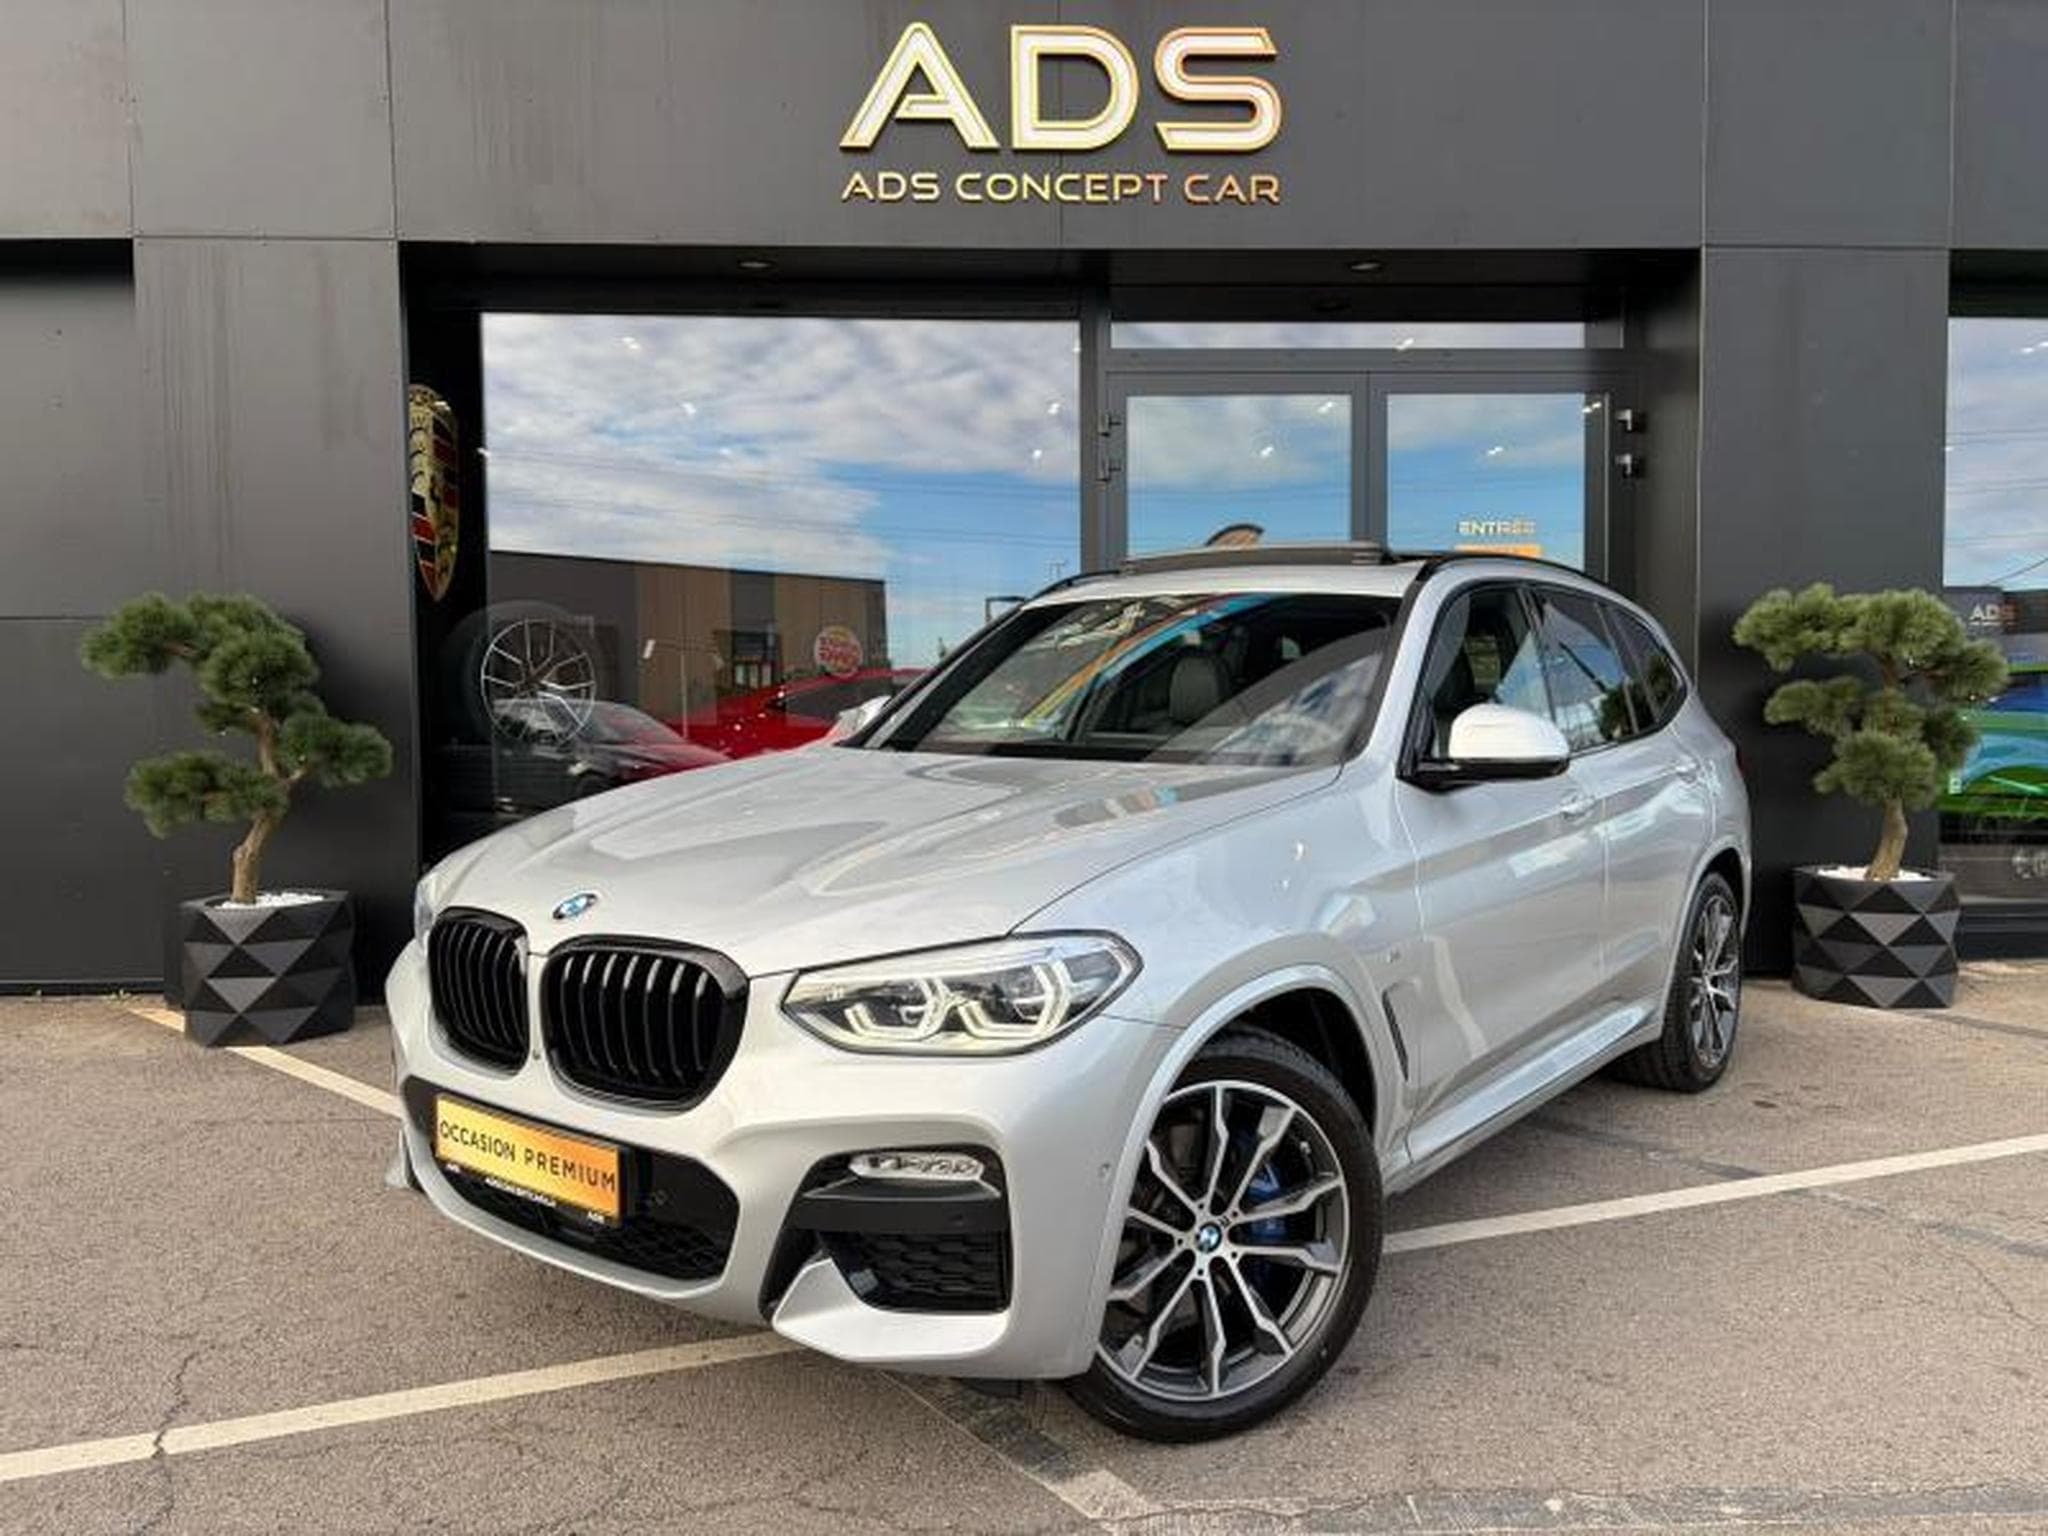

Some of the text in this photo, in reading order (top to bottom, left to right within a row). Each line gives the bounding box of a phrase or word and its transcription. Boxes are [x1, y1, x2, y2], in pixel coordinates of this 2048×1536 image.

[839, 21, 1283, 153] ADS
[841, 172, 1282, 204] ADS CONCEPT CAR
[439, 1120, 615, 1192] OCCASION PREMIUM
